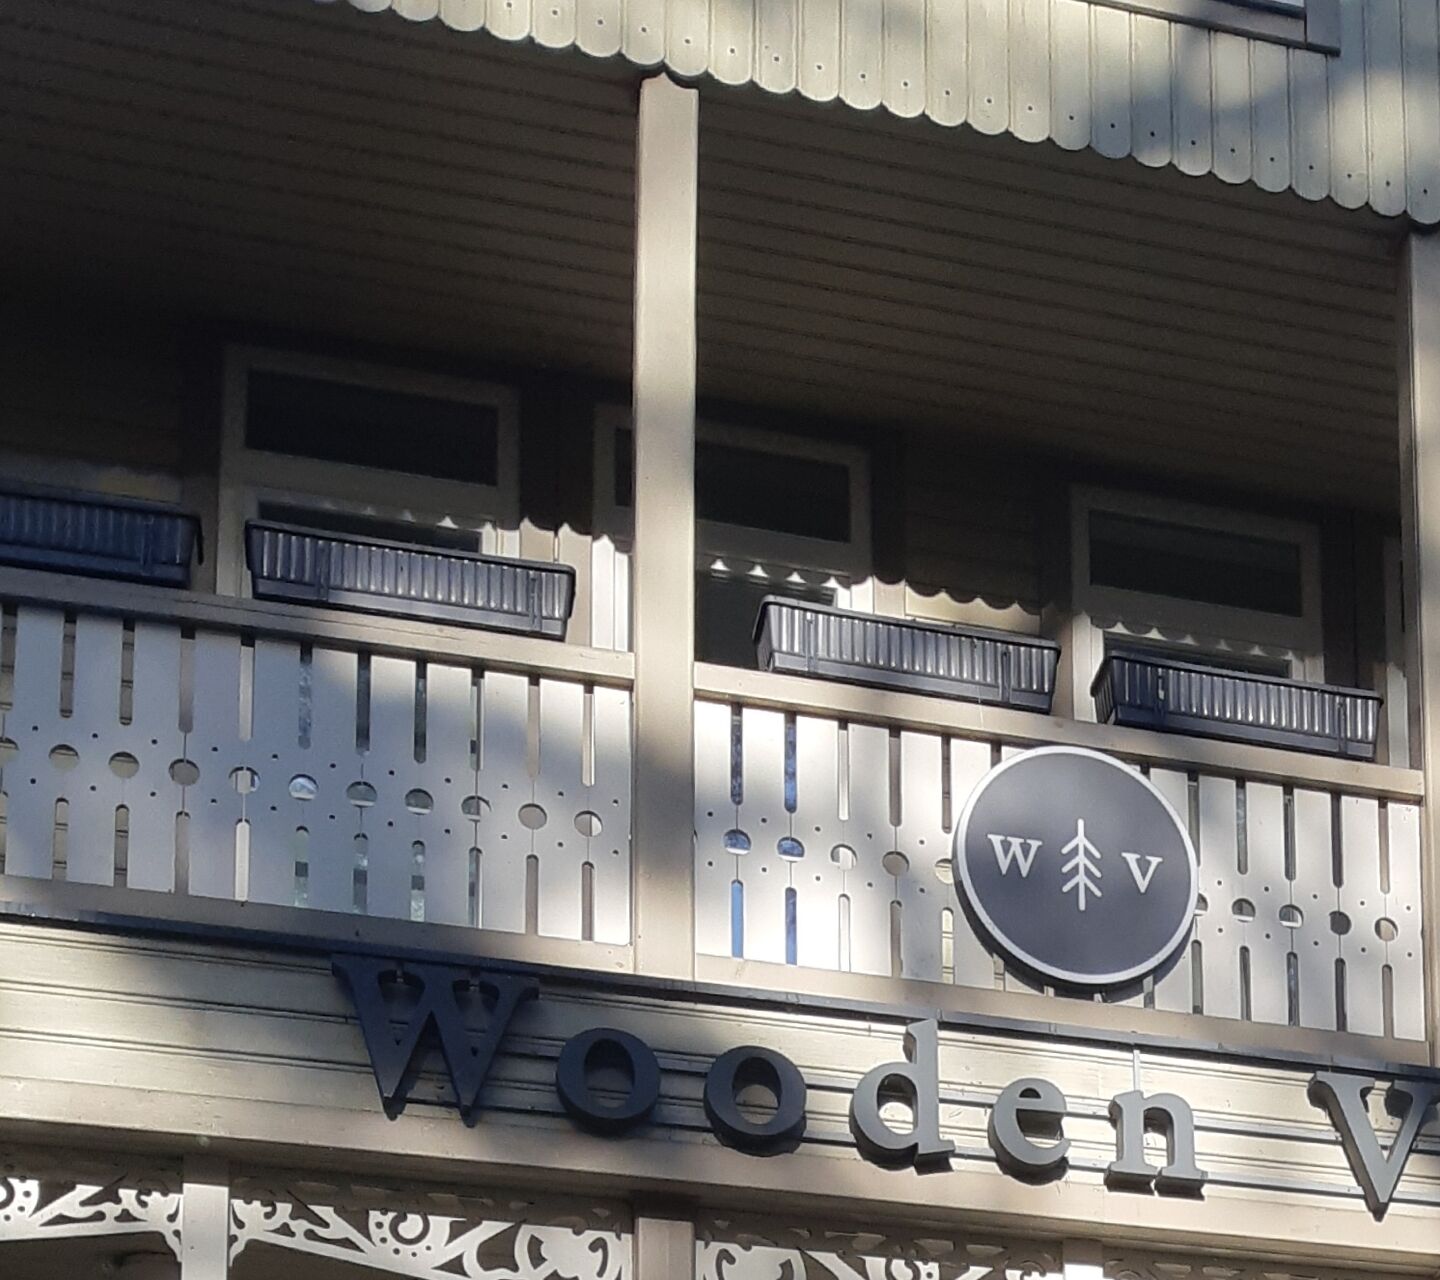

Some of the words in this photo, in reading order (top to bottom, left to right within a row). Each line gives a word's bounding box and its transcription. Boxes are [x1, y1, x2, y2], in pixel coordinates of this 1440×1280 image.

[987, 834, 1042, 878] W
[1121, 852, 1163, 893] V
[331, 954, 1208, 1198] Wooden
